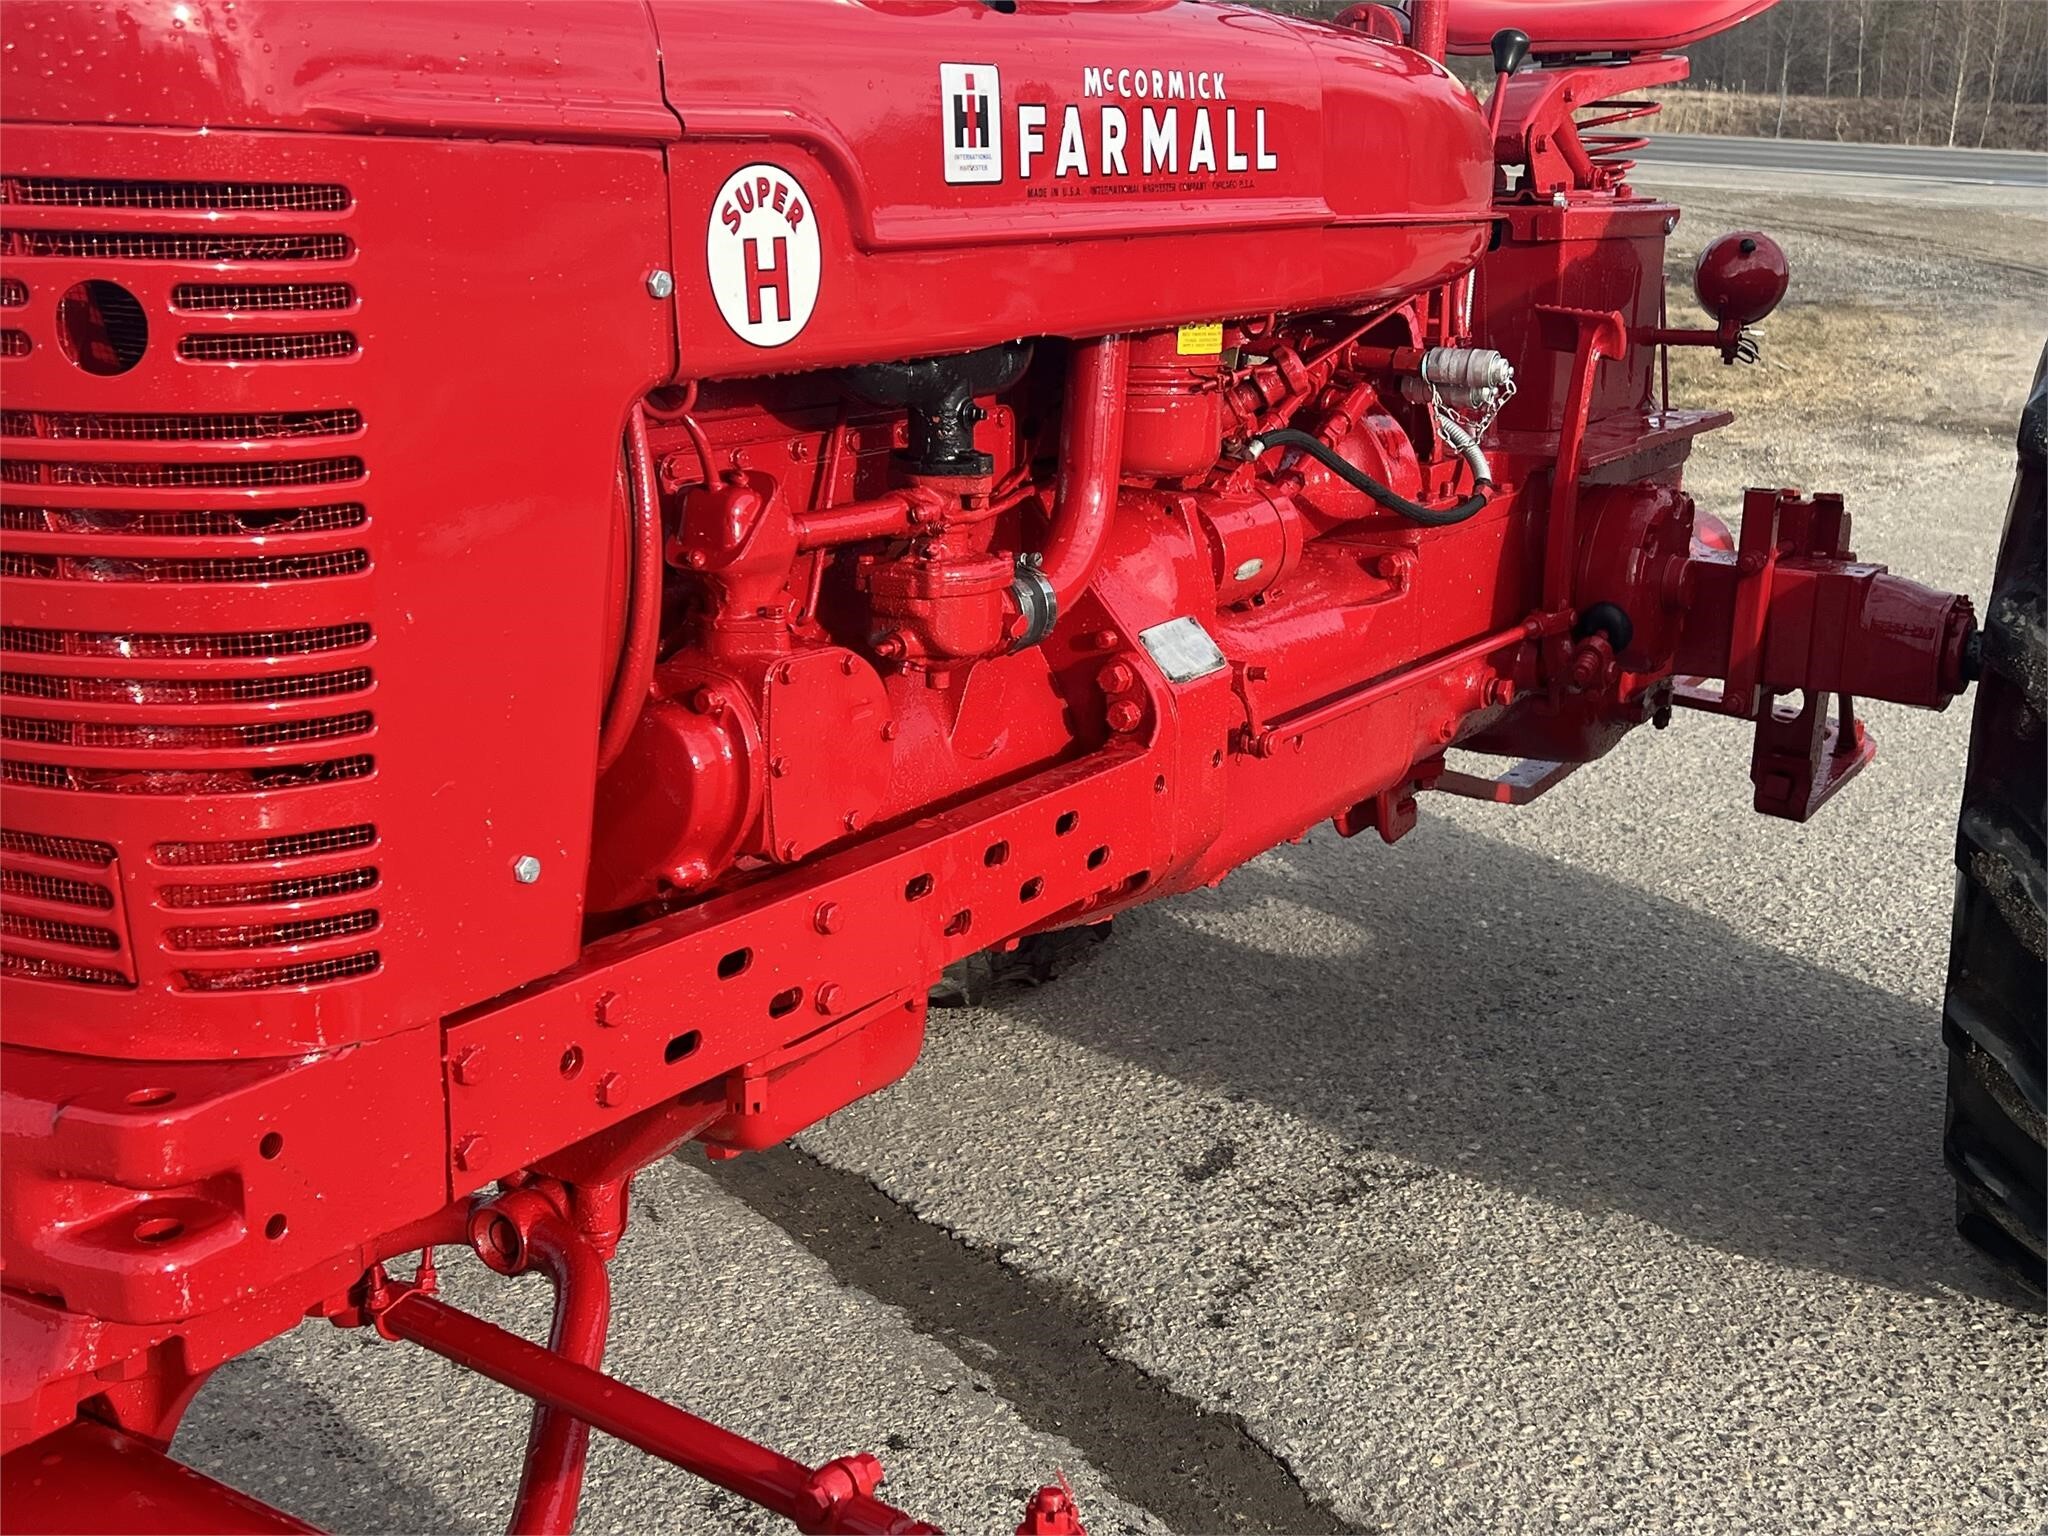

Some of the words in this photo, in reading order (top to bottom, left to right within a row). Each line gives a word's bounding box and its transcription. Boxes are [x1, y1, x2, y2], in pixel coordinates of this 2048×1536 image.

[1018, 103, 1278, 178] FARMALL
[721, 177, 804, 236] SUPER
[1027, 188, 1047, 197] MADE
[1051, 187, 1059, 197] IN
[1090, 184, 1139, 195] INTERNATIONAL
[743, 236, 791, 325] H
